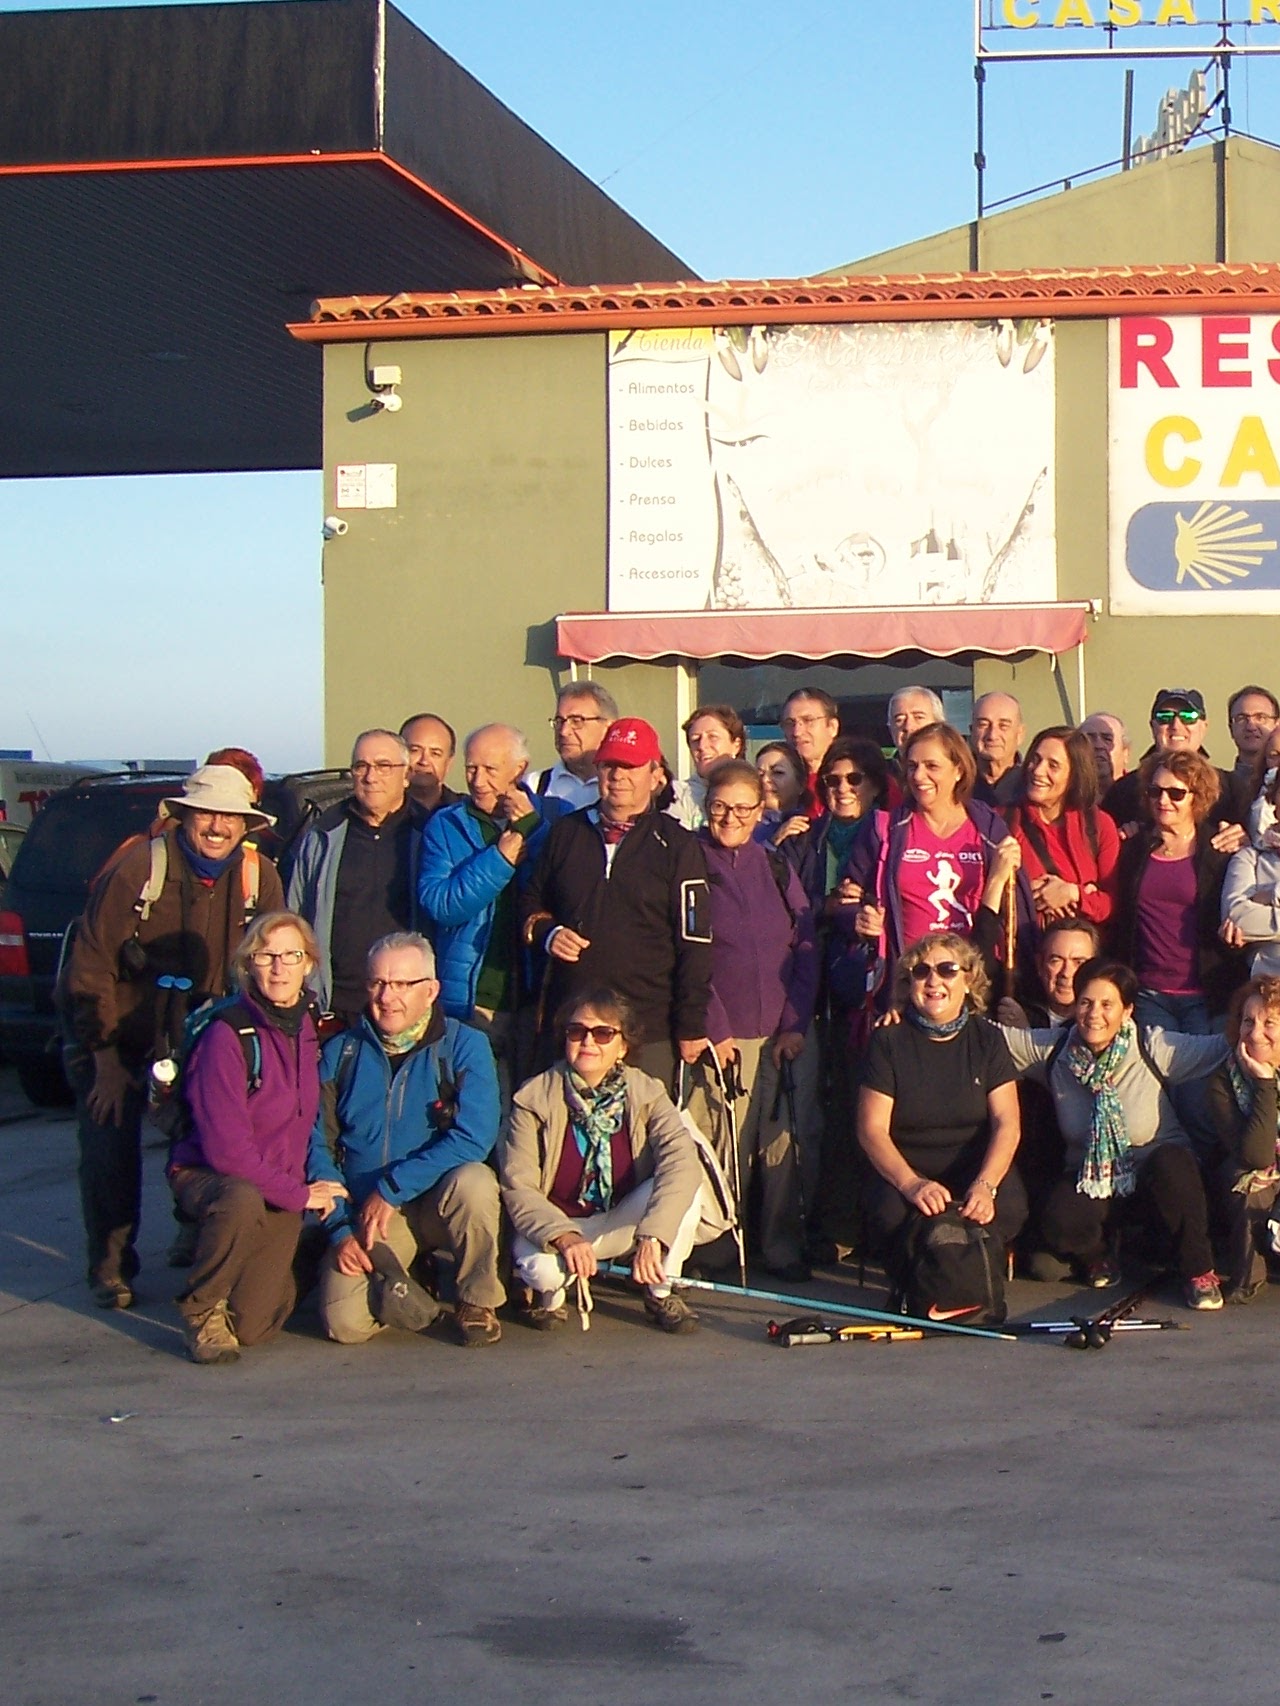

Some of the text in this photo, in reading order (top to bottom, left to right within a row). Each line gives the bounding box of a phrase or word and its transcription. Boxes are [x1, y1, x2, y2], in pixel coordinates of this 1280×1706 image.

[628, 382, 695, 394] Alimentos
[629, 419, 684, 431] Bebidas
[629, 456, 673, 468] Dulces
[629, 493, 677, 505] Prensa
[629, 530, 684, 545] Regalos
[629, 567, 700, 580] Accesorios
